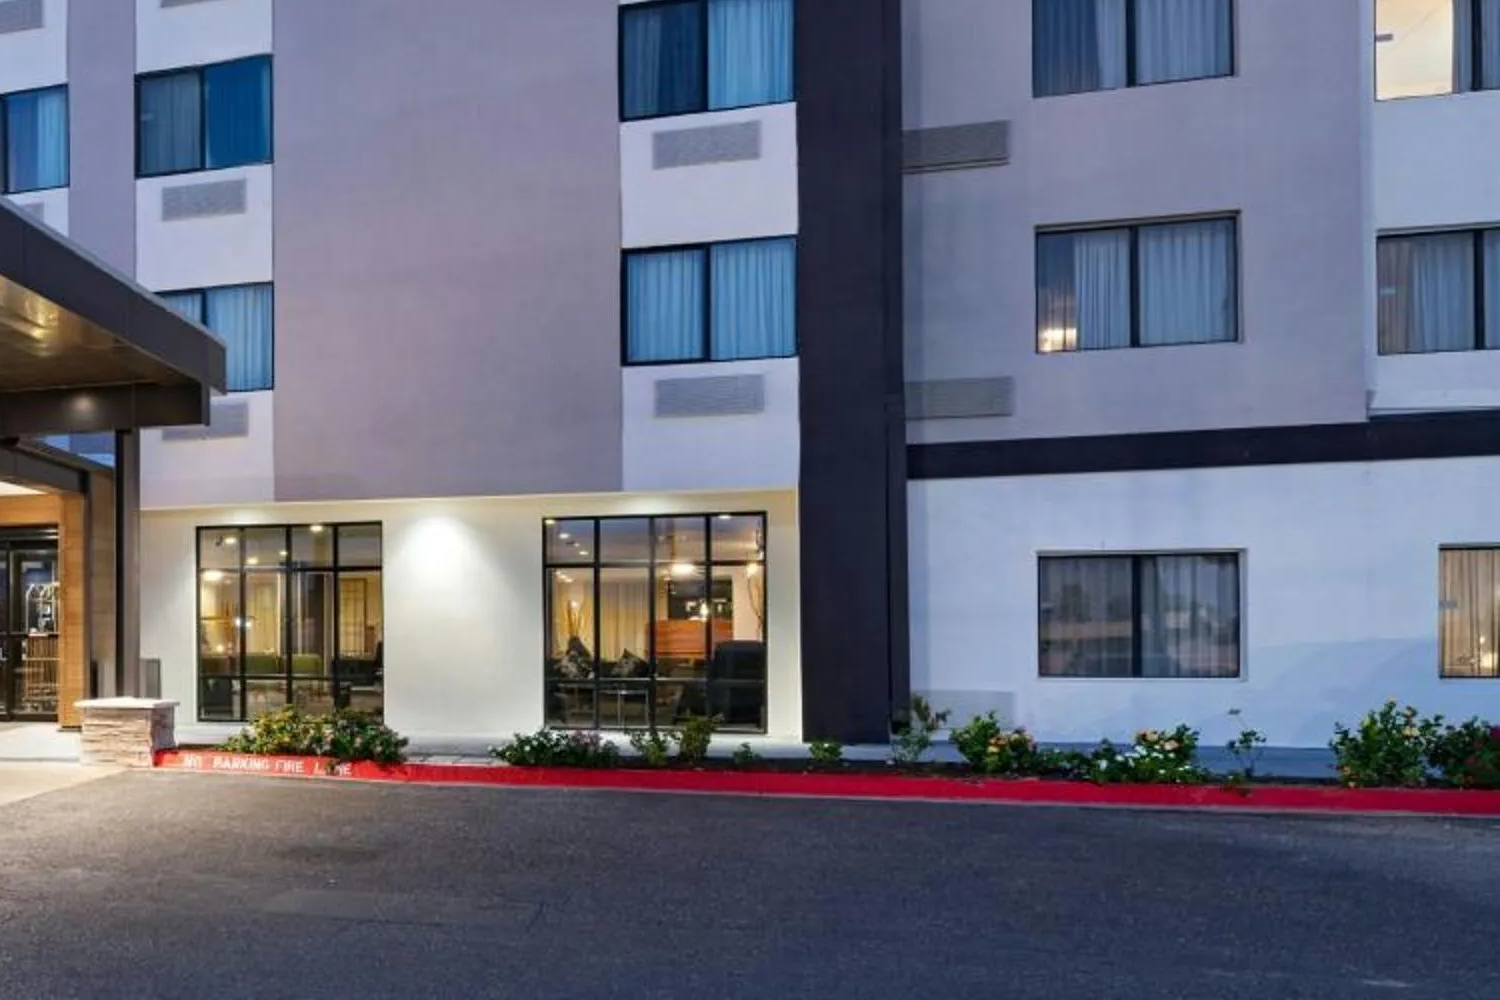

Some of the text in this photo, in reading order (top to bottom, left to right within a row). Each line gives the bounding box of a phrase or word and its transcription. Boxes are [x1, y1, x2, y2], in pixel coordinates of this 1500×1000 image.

[212, 755, 270, 771] PARKING
[275, 759, 305, 773] FIRE
[314, 761, 352, 776] LNE
